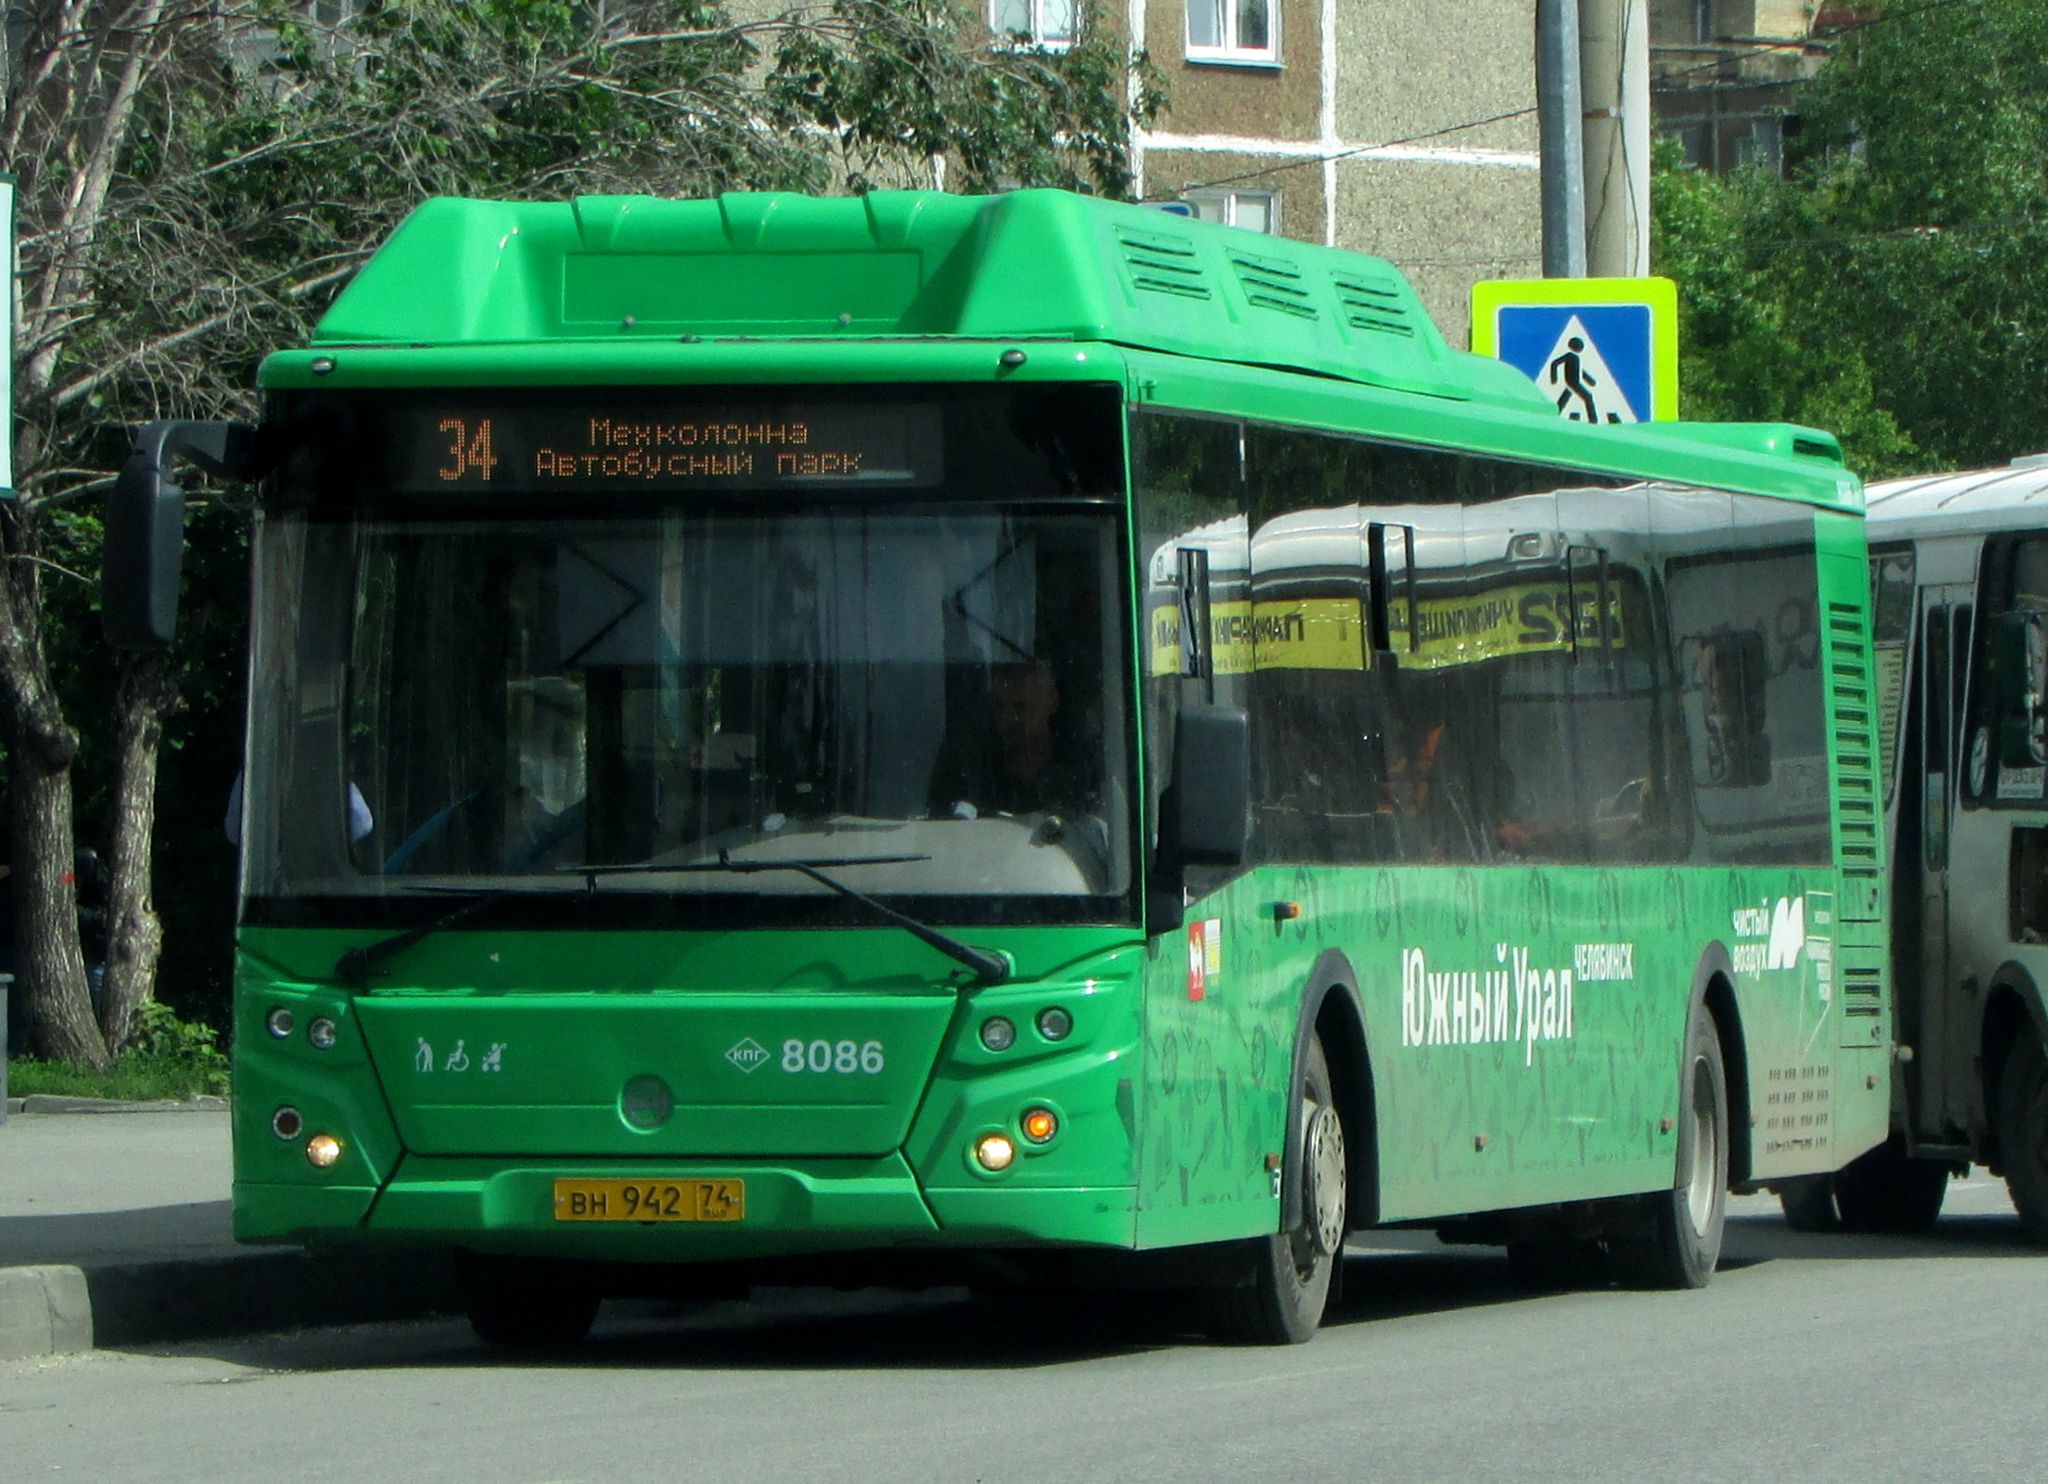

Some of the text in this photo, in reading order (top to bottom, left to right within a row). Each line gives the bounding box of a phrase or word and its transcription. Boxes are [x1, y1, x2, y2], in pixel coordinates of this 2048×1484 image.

[440, 419, 498, 481] 34
[536, 447, 863, 479] Автобусный парк
[1402, 943, 1572, 1066] Южный Урал
[781, 1038, 884, 1074] 8086
[623, 1186, 681, 1215] 942
[701, 1184, 731, 1206] 74
